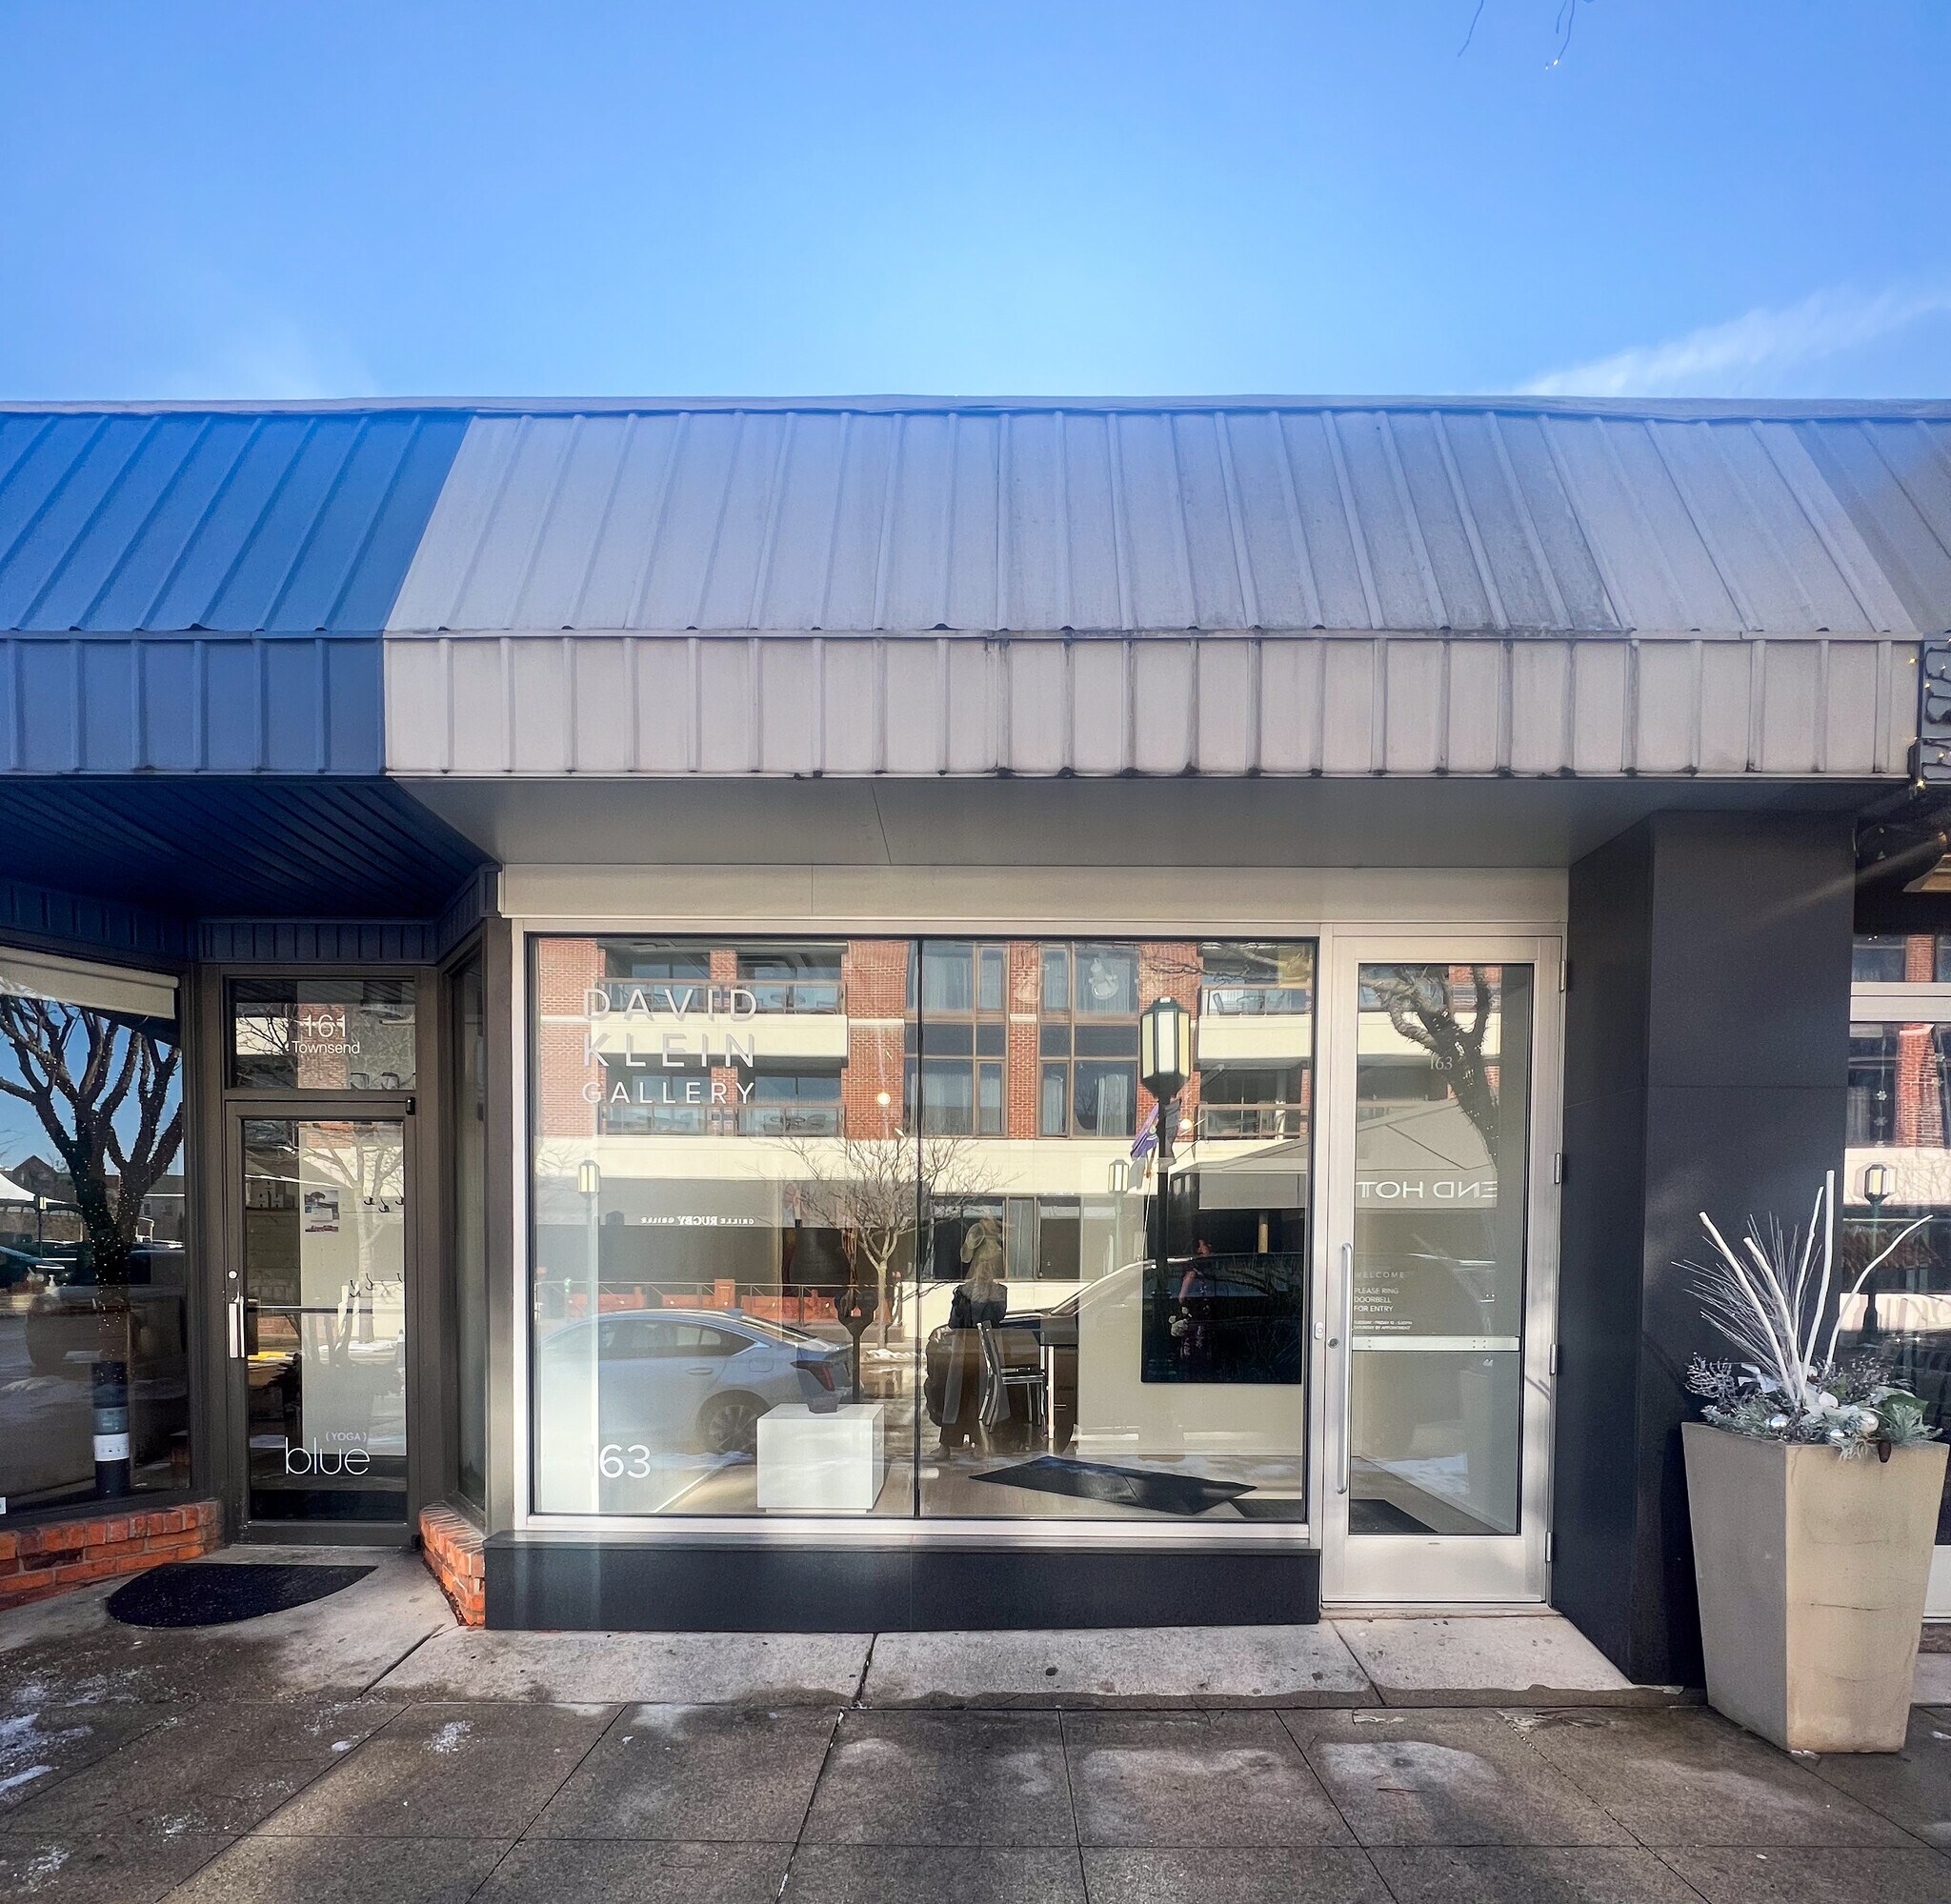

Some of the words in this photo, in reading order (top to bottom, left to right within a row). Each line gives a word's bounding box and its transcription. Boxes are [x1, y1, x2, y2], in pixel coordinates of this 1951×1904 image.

[582, 988, 758, 1022] DAVID
[302, 1013, 346, 1038] 161
[291, 1040, 360, 1054] Townsend
[582, 1032, 755, 1068] KLEIN
[1430, 1054, 1453, 1071] 163
[581, 1081, 754, 1104] GALLERY
[1355, 1271, 1405, 1279] WELCOME
[1354, 1295, 1392, 1304] DOORBELL
[285, 1436, 371, 1475] blue
